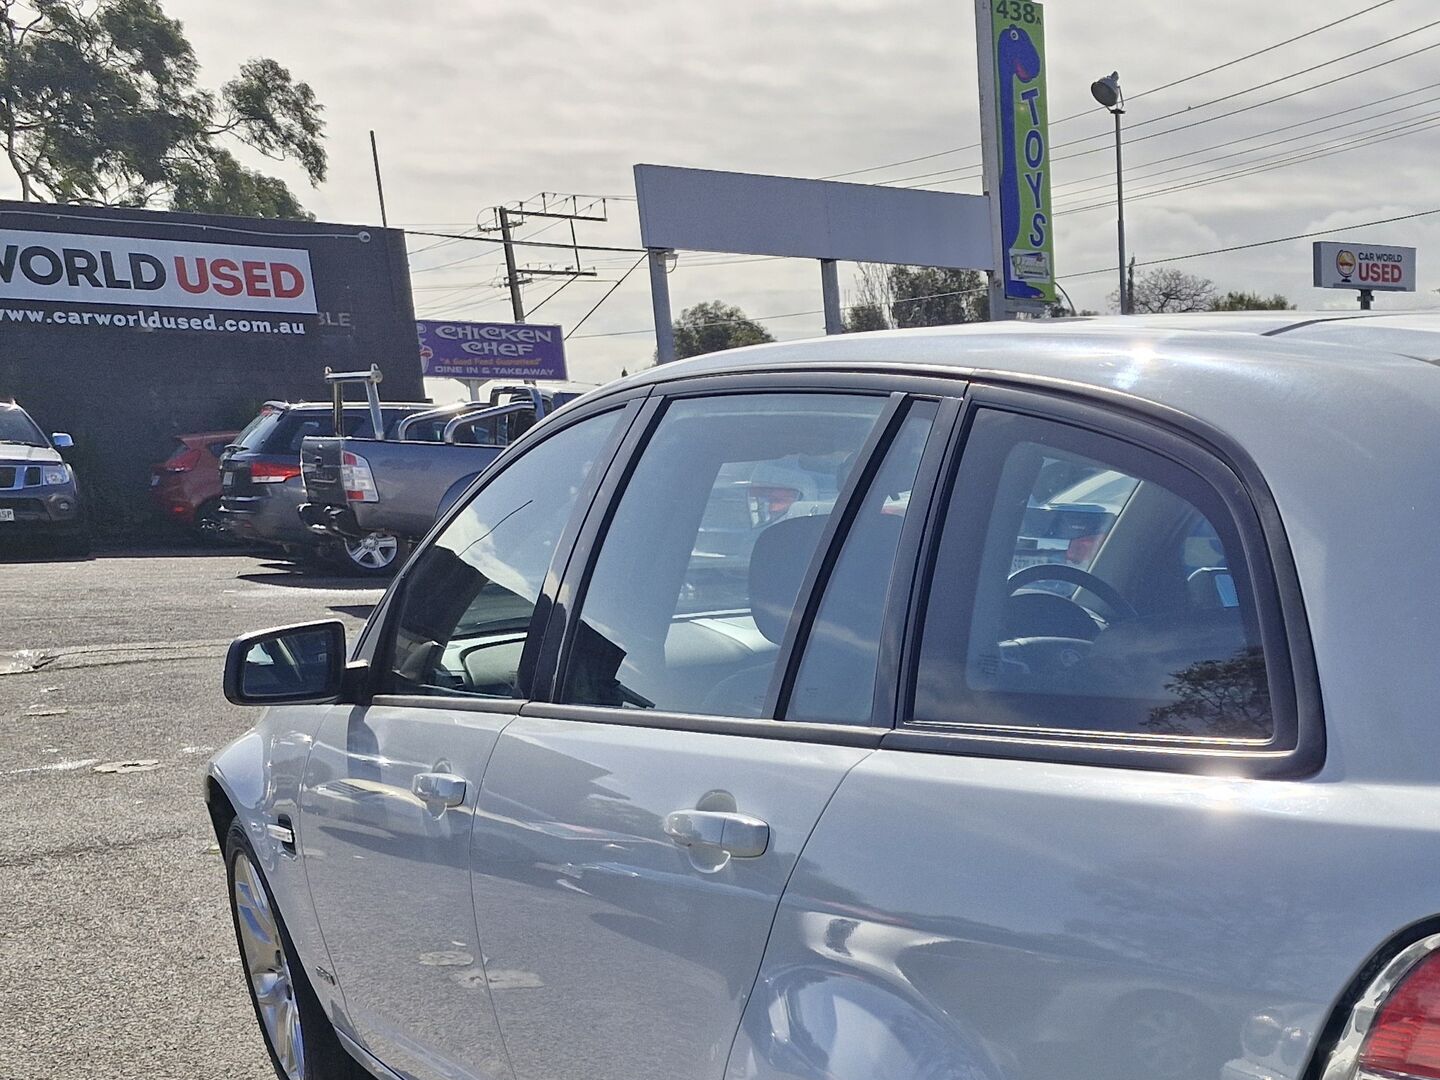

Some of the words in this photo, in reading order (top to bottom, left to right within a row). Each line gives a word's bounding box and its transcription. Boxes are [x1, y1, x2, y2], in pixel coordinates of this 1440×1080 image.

[1020, 88, 1046, 247] TOYS
[1358, 252, 1375, 262] CAR
[1377, 253, 1403, 263] WORLD
[174, 255, 305, 299] USED
[1358, 263, 1402, 283] USED
[0, 308, 306, 335] ww.carworldused.com.au
[435, 325, 552, 343] CHICKEN
[461, 341, 534, 357] CHEF
[434, 366, 463, 374] DINE
[466, 366, 478, 374] IN
[492, 367, 555, 376] TAKEAWAY
